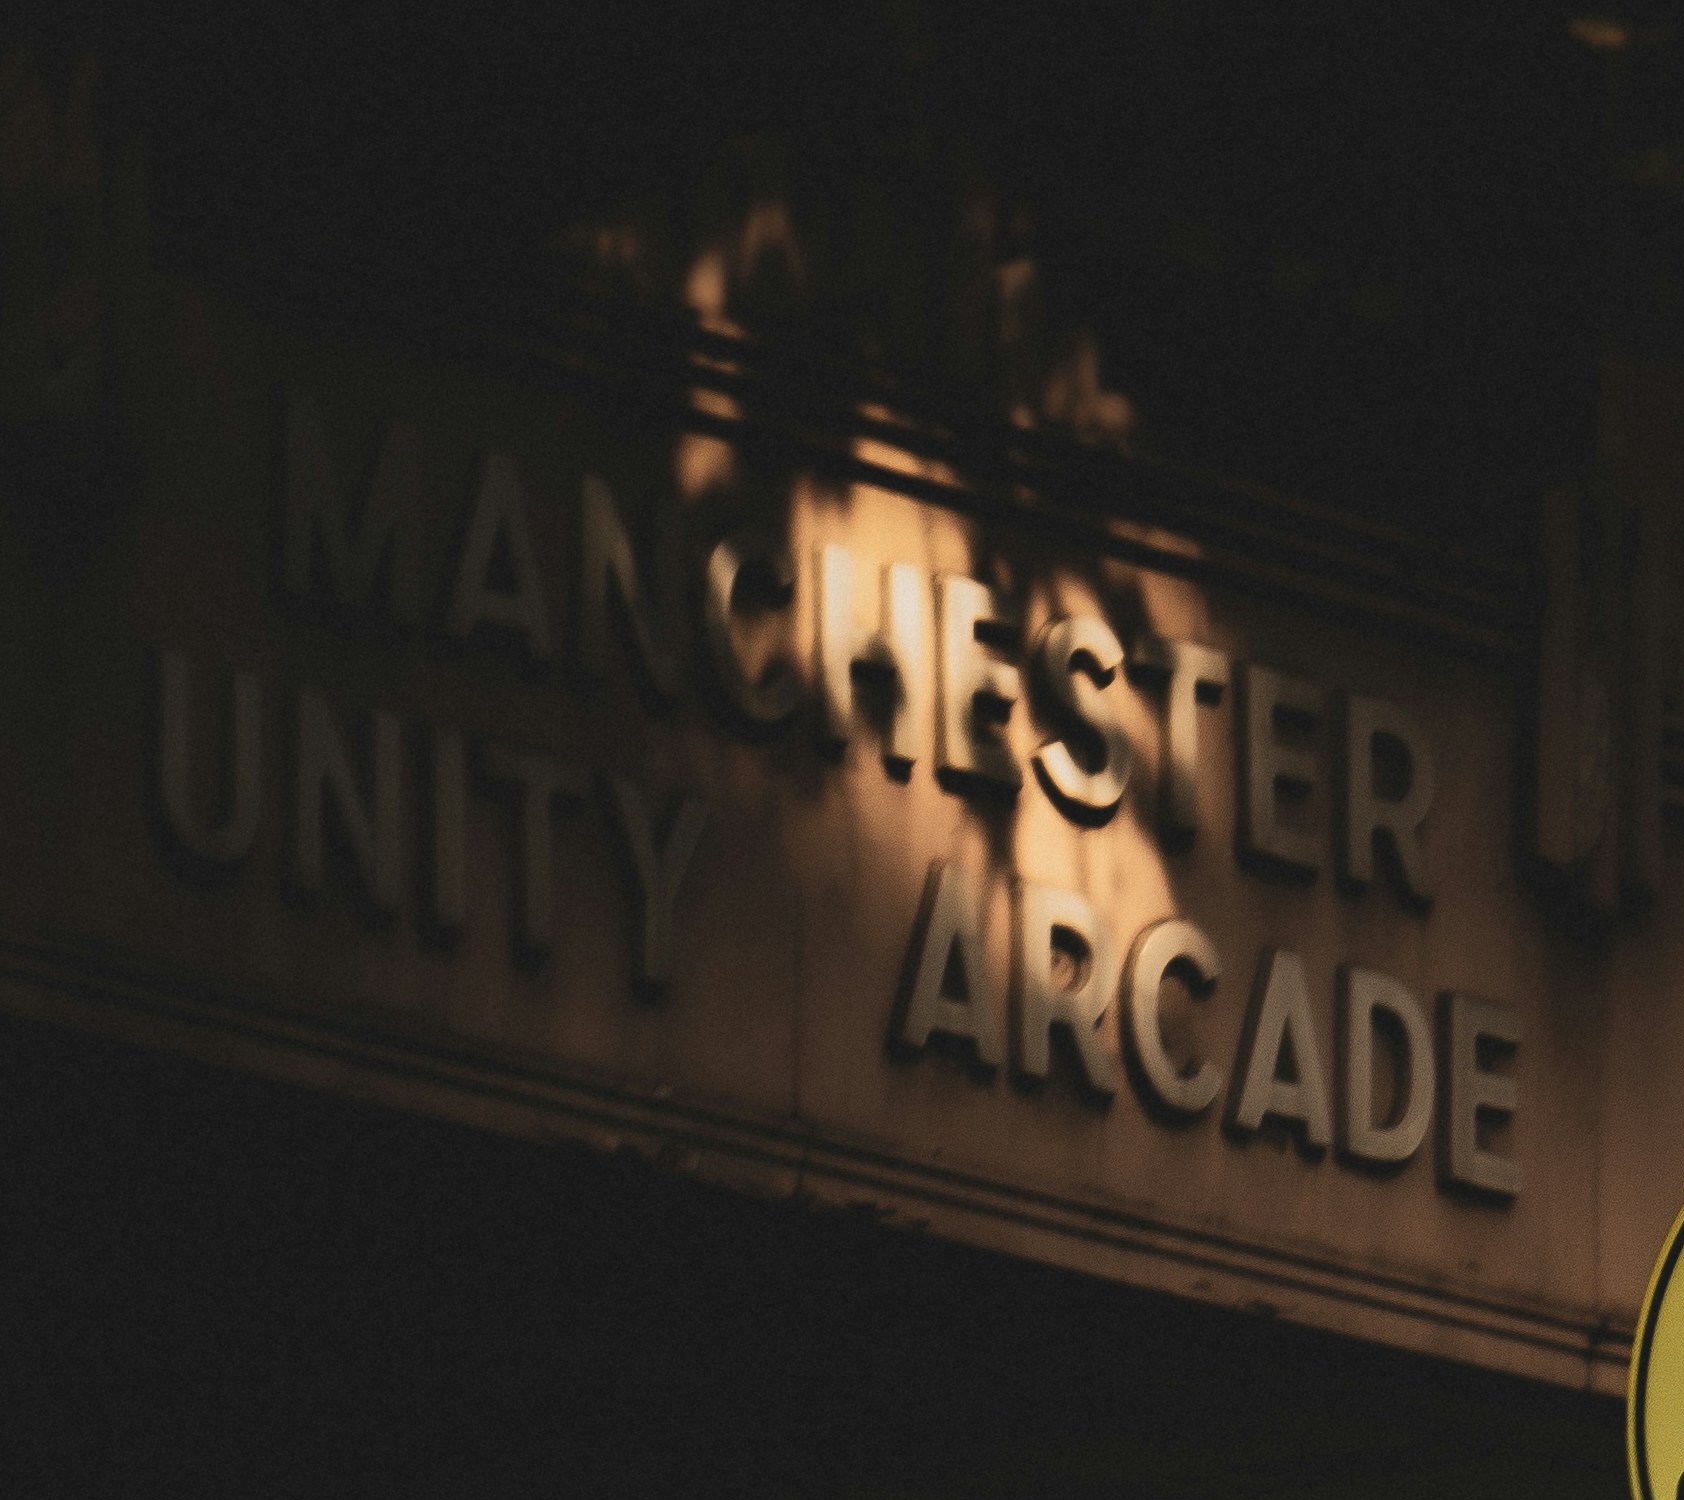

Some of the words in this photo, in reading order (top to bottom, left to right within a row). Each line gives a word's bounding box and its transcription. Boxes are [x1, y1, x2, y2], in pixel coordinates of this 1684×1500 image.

[270, 385, 1437, 908] MANCHESTER
[148, 648, 708, 998] UNITY
[893, 858, 1522, 1205] ARCADE
